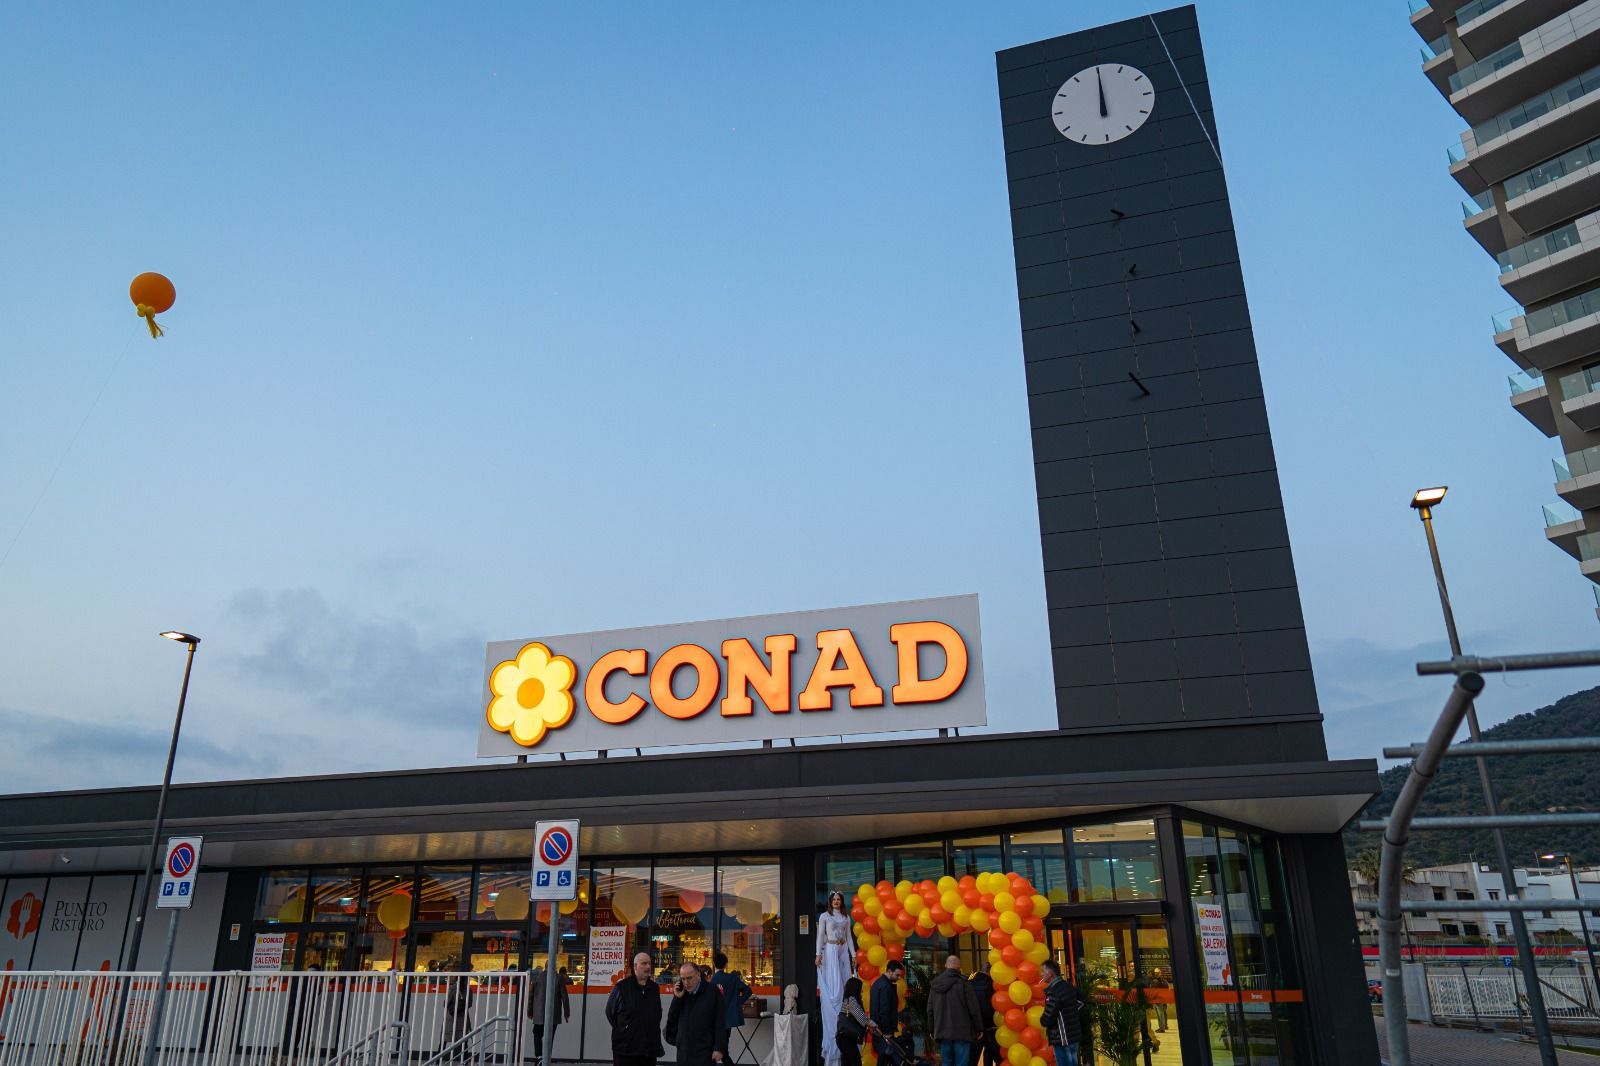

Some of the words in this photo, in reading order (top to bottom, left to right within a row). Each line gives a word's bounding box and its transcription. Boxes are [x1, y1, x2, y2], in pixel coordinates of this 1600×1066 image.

[585, 620, 968, 725] CONAD
[539, 872, 548, 885] P
[165, 883, 173, 895] P
[55, 901, 107, 917] PUNTO
[1205, 909, 1221, 919] CONAD
[52, 918, 104, 931] RISTORO
[1203, 938, 1226, 949] SALERNO
[254, 956, 280, 964] SALERNO
[591, 951, 623, 960] SALERNO
